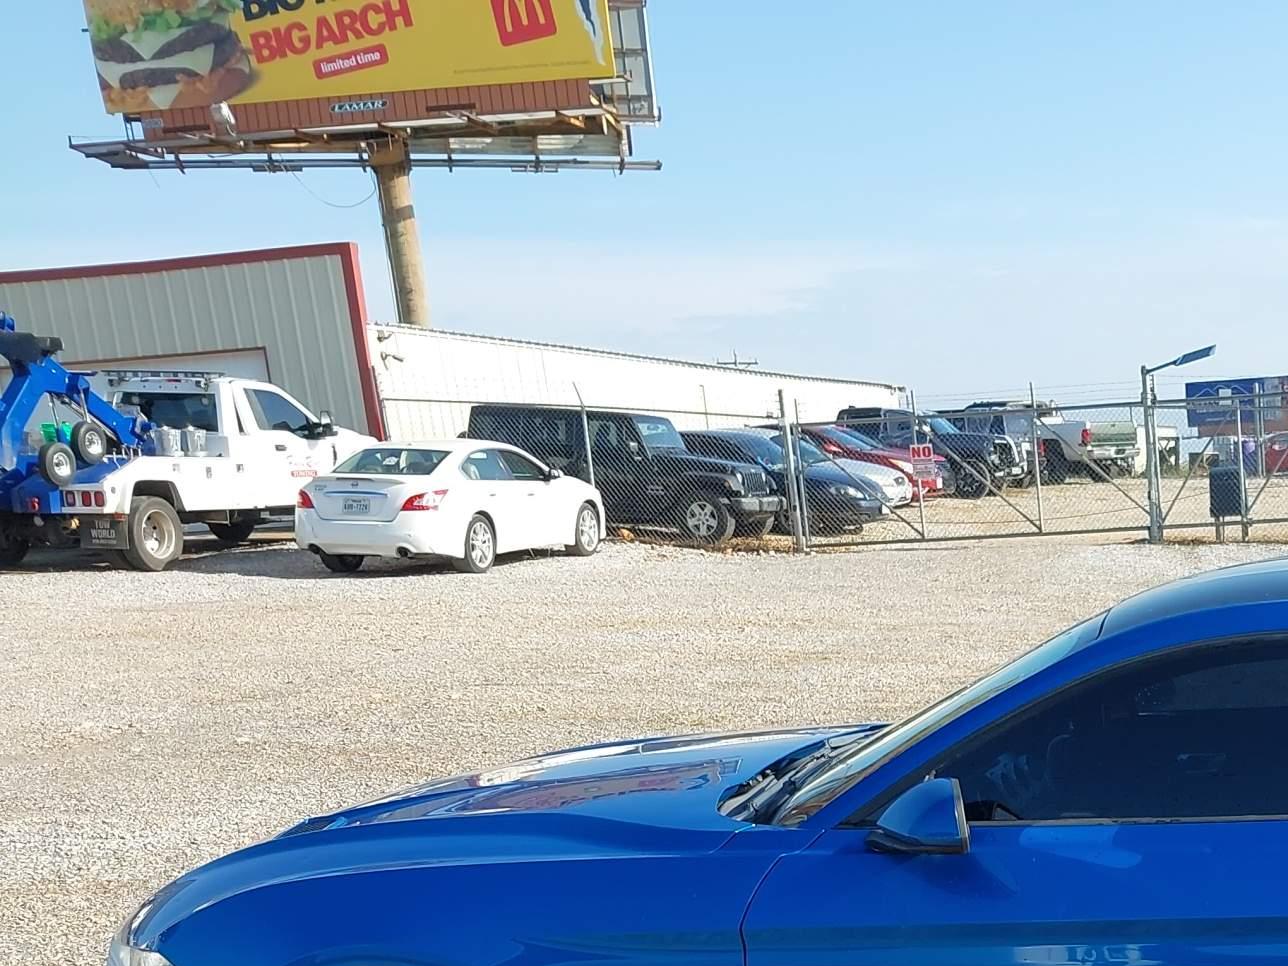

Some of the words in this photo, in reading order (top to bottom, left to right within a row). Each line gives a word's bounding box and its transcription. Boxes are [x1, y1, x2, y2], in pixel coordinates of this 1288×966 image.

[249, 21, 312, 64] BIG
[315, 0, 413, 50] ARCH
[320, 55, 357, 73] limited
[356, 51, 381, 65] time
[333, 100, 384, 113] LAMAR
[911, 446, 932, 458] NO
[90, 528, 116, 539] WORLD
